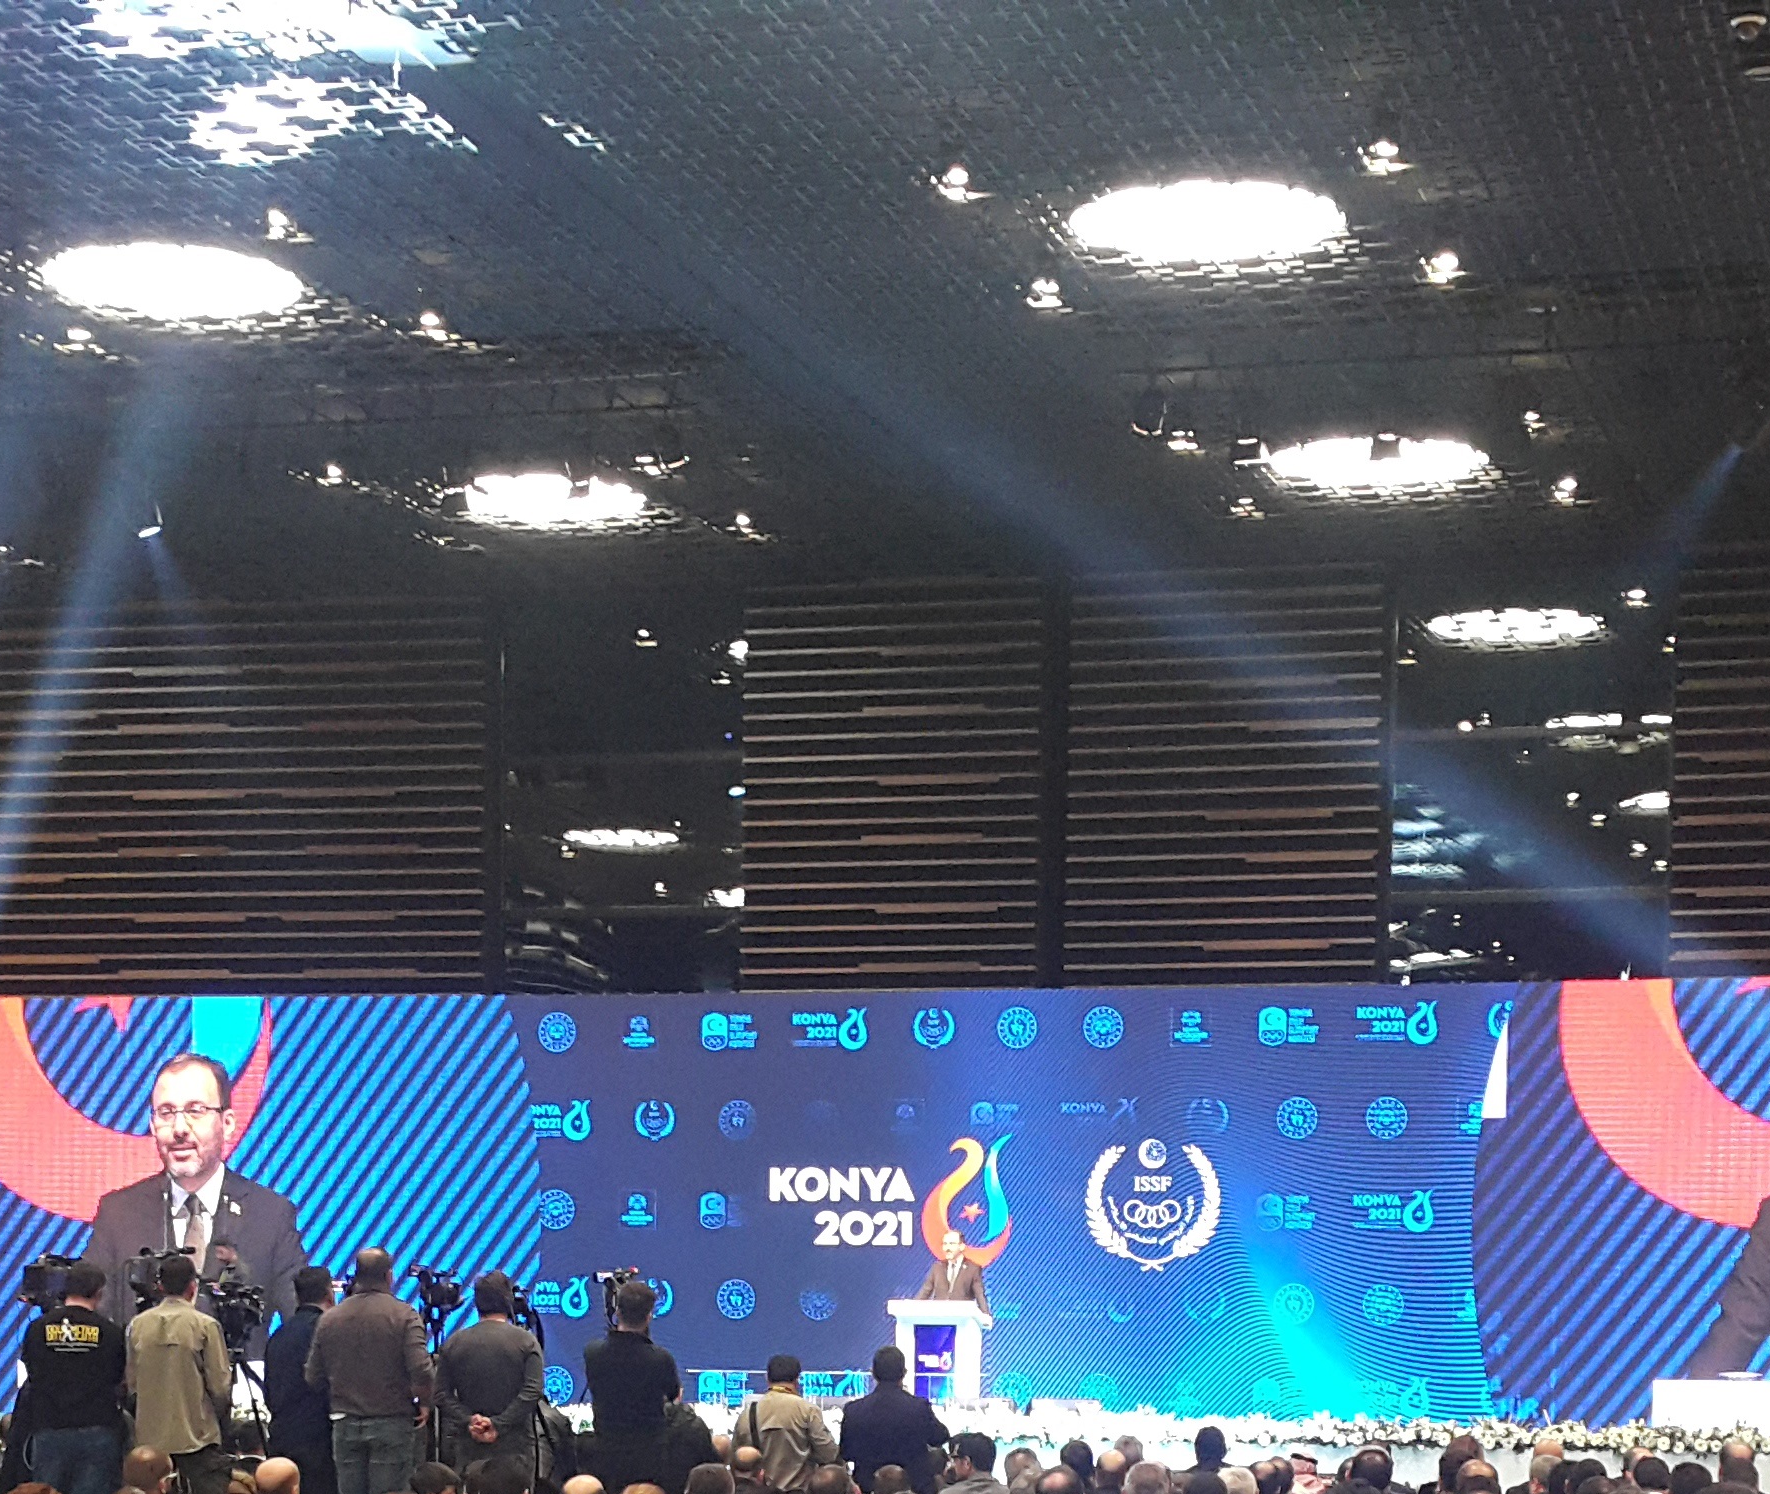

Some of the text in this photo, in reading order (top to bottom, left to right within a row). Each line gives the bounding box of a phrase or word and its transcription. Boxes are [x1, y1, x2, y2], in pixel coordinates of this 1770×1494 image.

[792, 1012, 837, 1025] KONYA
[1356, 1006, 1406, 1019] KONYA
[806, 1027, 837, 1038] 2021
[1372, 1021, 1405, 1033] 2021
[769, 1166, 916, 1202] KONYA
[1133, 1176, 1173, 1192] ISSF
[1352, 1194, 1401, 1206] KONYA
[1368, 1208, 1401, 1220] 2021
[813, 1210, 913, 1246] 2021
